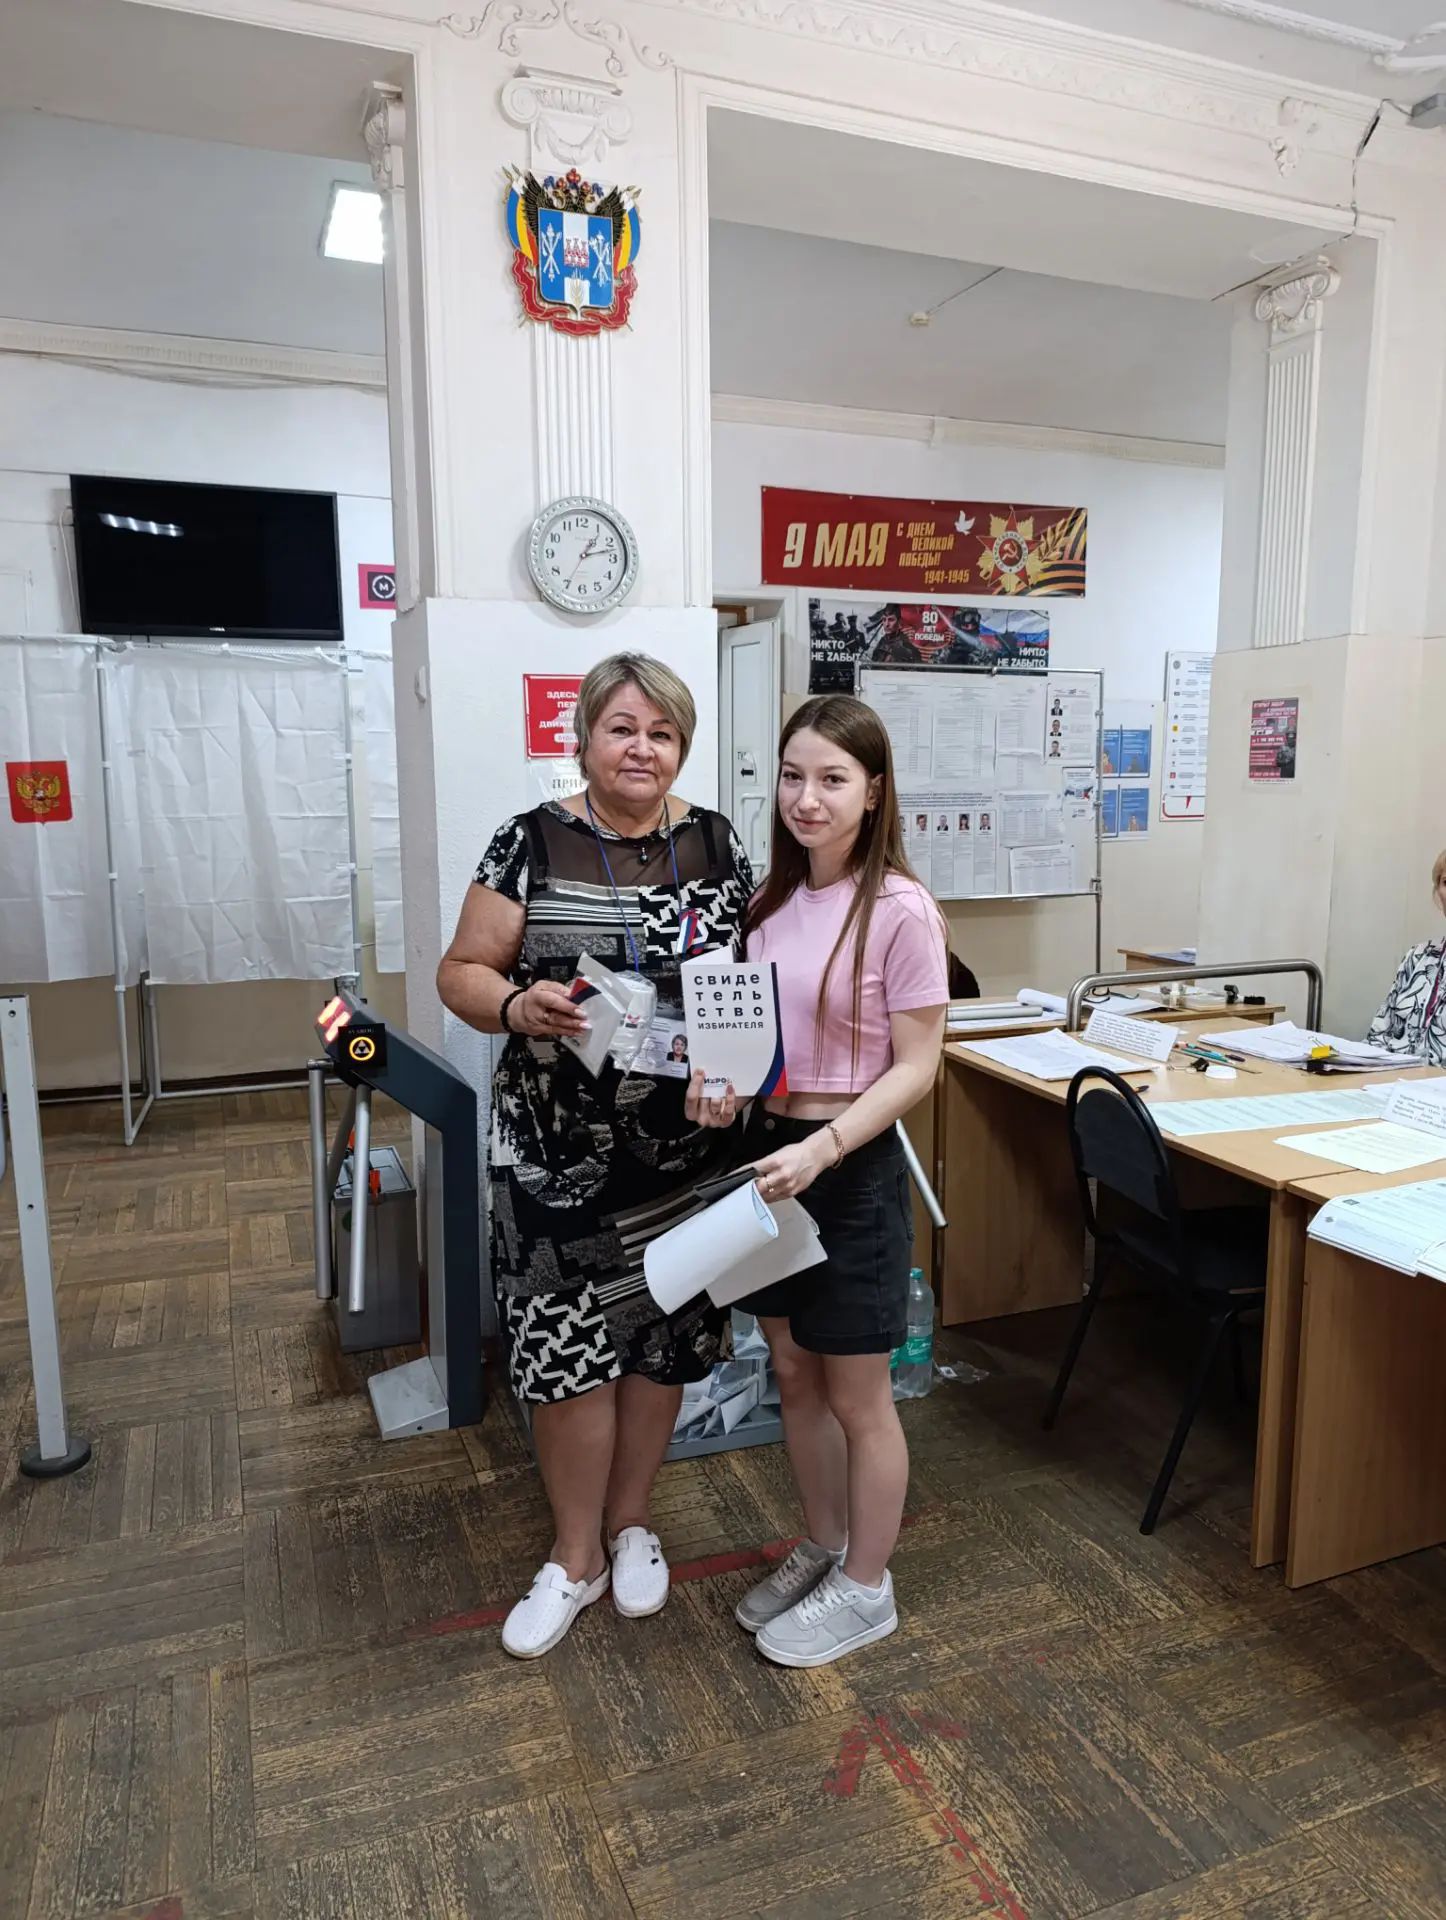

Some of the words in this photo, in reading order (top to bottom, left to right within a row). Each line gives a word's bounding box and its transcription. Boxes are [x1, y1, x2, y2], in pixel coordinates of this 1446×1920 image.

[563, 521, 571, 531] 11
[575, 517, 588, 528] 12
[596, 524, 600, 533] 1
[896, 522, 904, 537] С
[906, 522, 935, 538] ДНЕМ
[550, 533, 560, 543] 10
[605, 537, 614, 547] 2
[911, 535, 954, 551] ВЕЛИКОЙ
[783, 522, 807, 568] 9
[812, 522, 889, 567] МАЯ
[546, 549, 554, 559] 9
[609, 553, 617, 564] 3
[899, 552, 941, 568] ПОБЕДЫ!
[552, 566, 560, 576] 8
[603, 571, 611, 580] 4
[924, 569, 970, 584] 1941-1945
[563, 579, 571, 589] 7
[578, 584, 587, 594] 6
[594, 582, 601, 592] 5
[922, 611, 938, 624] 80
[914, 633, 945, 642] ПОБЕДЫ
[811, 640, 846, 650] НИКТО
[811, 652, 825, 662] НЕ
[1019, 647, 1046, 657] НИЧТО
[997, 657, 1010, 668] НЕ
[546, 691, 578, 699] ЗДЕСЬ
[697, 1021, 764, 1030] ИЗБИРАТЕЛЯ
